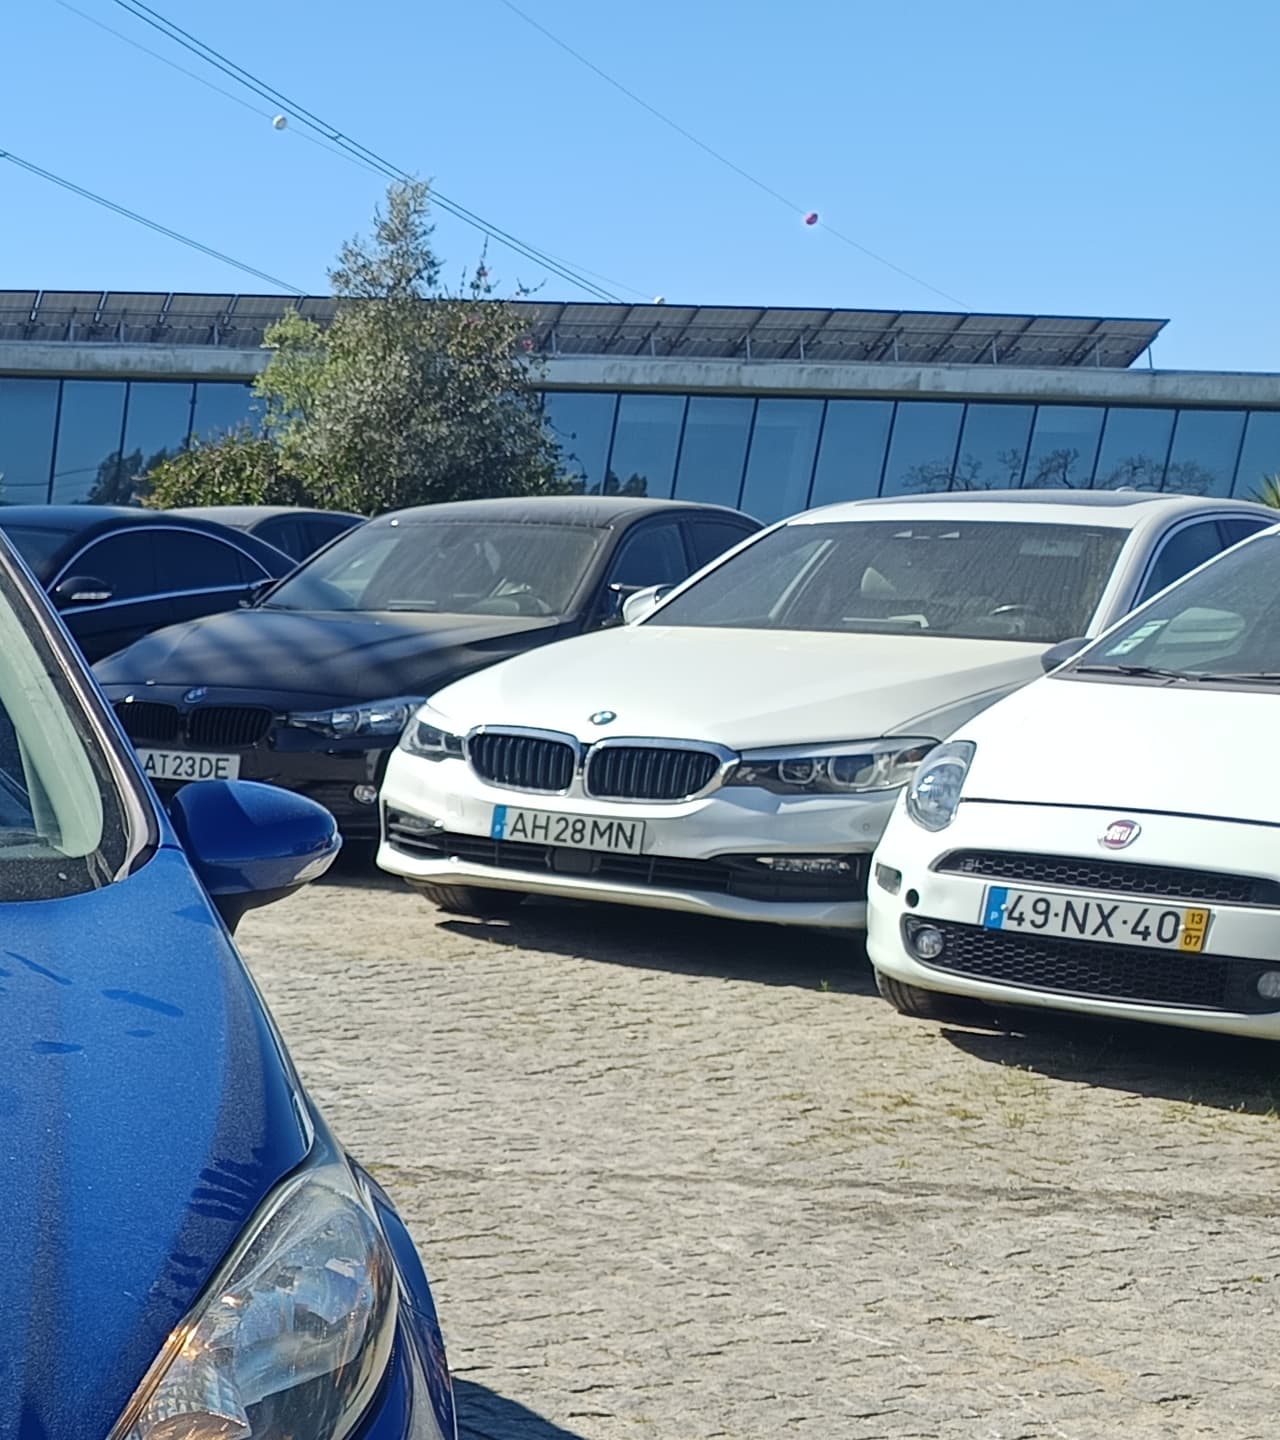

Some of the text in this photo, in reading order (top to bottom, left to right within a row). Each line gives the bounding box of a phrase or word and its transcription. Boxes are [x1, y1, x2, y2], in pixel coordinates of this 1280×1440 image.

[509, 812, 636, 849] AH28MN
[990, 911, 999, 921] P
[1190, 912, 1204, 925] 13
[1183, 934, 1201, 947] 07
